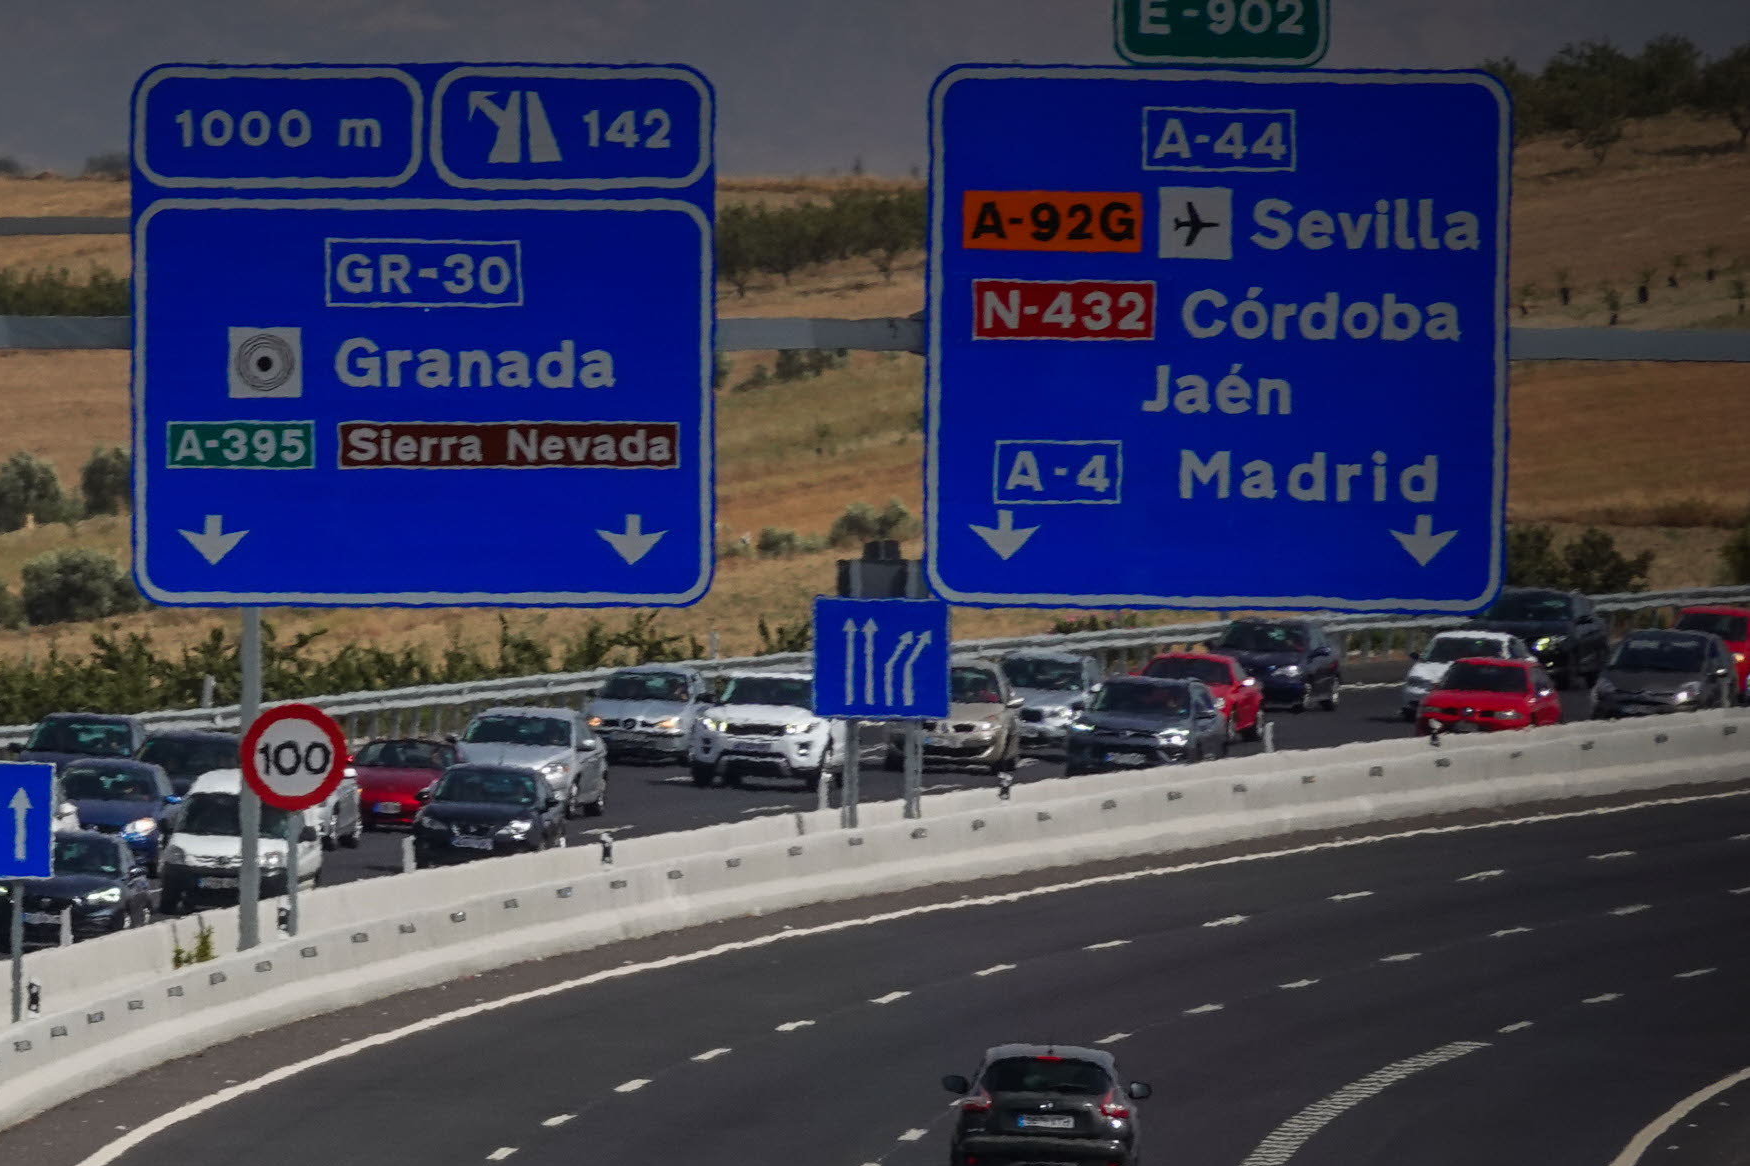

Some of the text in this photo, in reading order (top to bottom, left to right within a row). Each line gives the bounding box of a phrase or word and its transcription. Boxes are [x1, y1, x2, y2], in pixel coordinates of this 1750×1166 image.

[1138, 0, 1305, 36] E-902
[175, 109, 383, 149] 1000 m
[582, 109, 672, 149] 142
[1153, 118, 1288, 161] A-44
[971, 201, 1137, 242] A-92G
[1250, 198, 1481, 252] Sevilla
[335, 253, 512, 296] GR-30
[982, 289, 1147, 331] N-432
[1182, 287, 1463, 342] Córdoba
[334, 336, 617, 390] Granada
[1141, 362, 1292, 416] Jaén
[175, 428, 306, 464] A-395
[346, 427, 673, 463] Sierra Nevada
[1005, 449, 1109, 493] A-4
[1179, 448, 1439, 503] Madrid
[259, 739, 331, 776] 100
